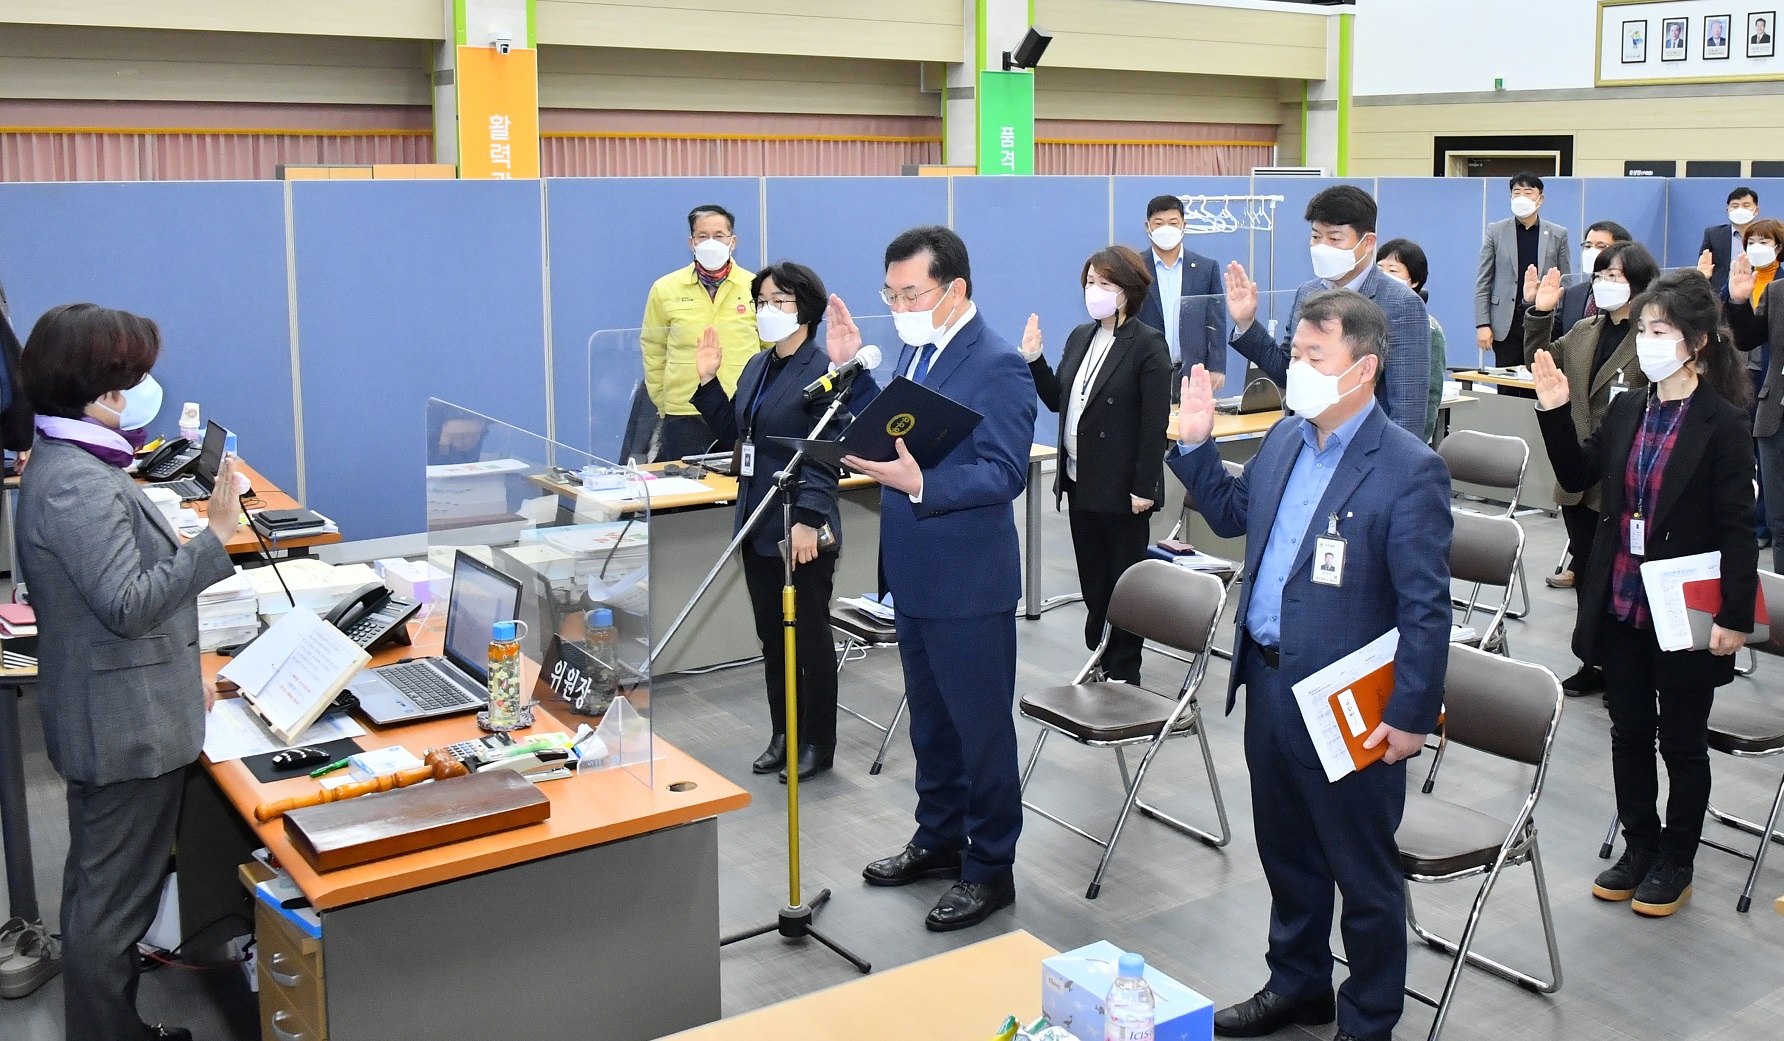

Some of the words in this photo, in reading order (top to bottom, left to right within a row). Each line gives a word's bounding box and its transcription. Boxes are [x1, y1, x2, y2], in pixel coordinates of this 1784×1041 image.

[488, 114, 512, 179] 활력
[1000, 126, 1015, 176] 품격
[550, 660, 593, 710] 위원장
